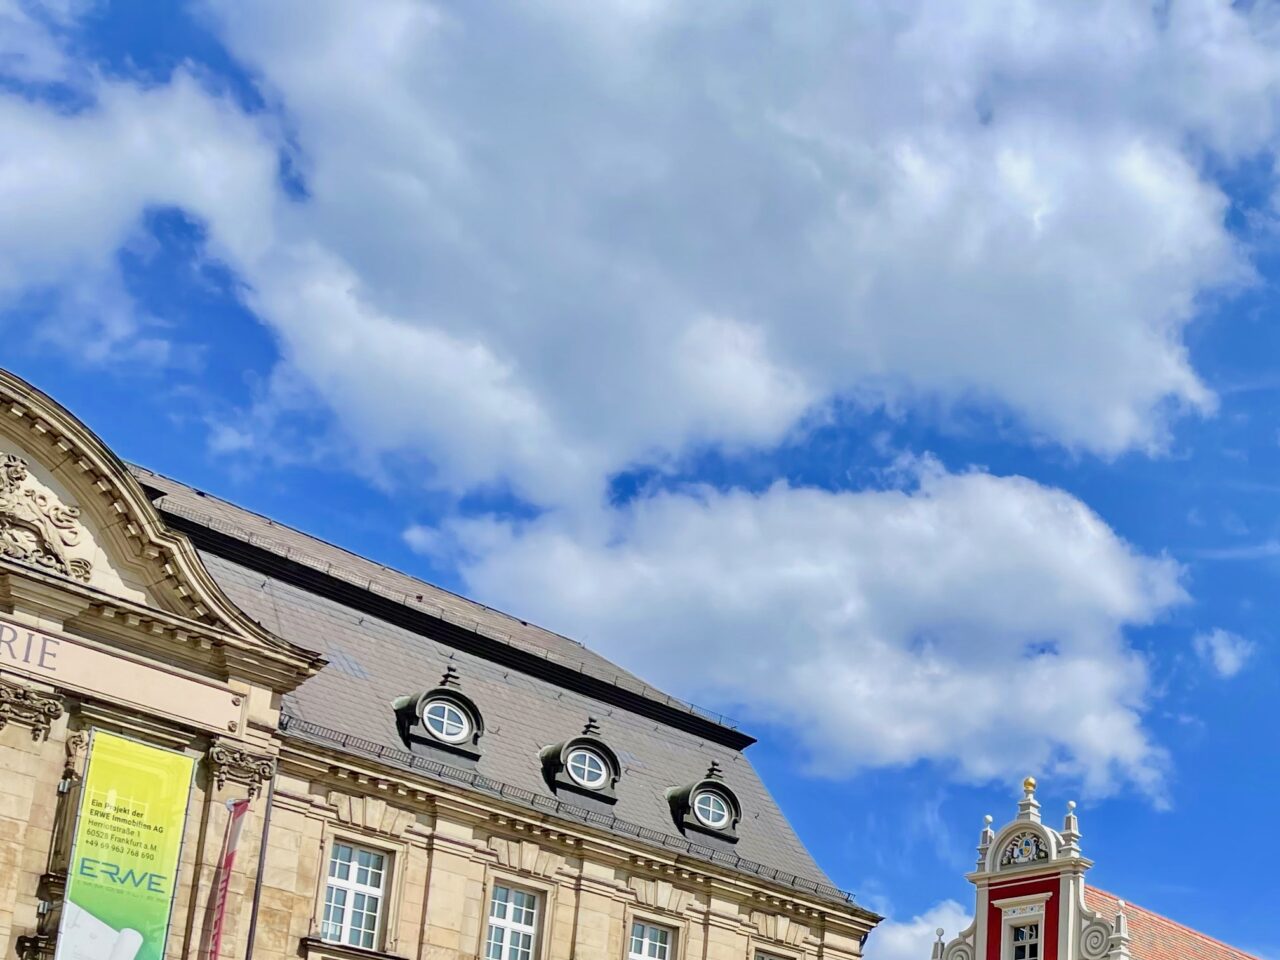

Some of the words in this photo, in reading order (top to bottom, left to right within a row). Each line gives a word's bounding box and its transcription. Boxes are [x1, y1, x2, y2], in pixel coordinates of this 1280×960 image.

[91, 799, 103, 808] Ein
[104, 801, 130, 815] Projekt
[131, 810, 145, 818] der
[88, 818, 135, 837] Herriotstraße
[89, 808, 110, 820] ERWE
[112, 814, 152, 831] Immobilien
[153, 826, 164, 834] AG
[85, 838, 98, 847] +49
[100, 841, 109, 849] 69
[111, 844, 124, 854] 963
[126, 848, 139, 858] 768
[141, 851, 155, 861] 690
[110, 834, 143, 848] Frankfurt
[79, 857, 167, 894] ERWE
